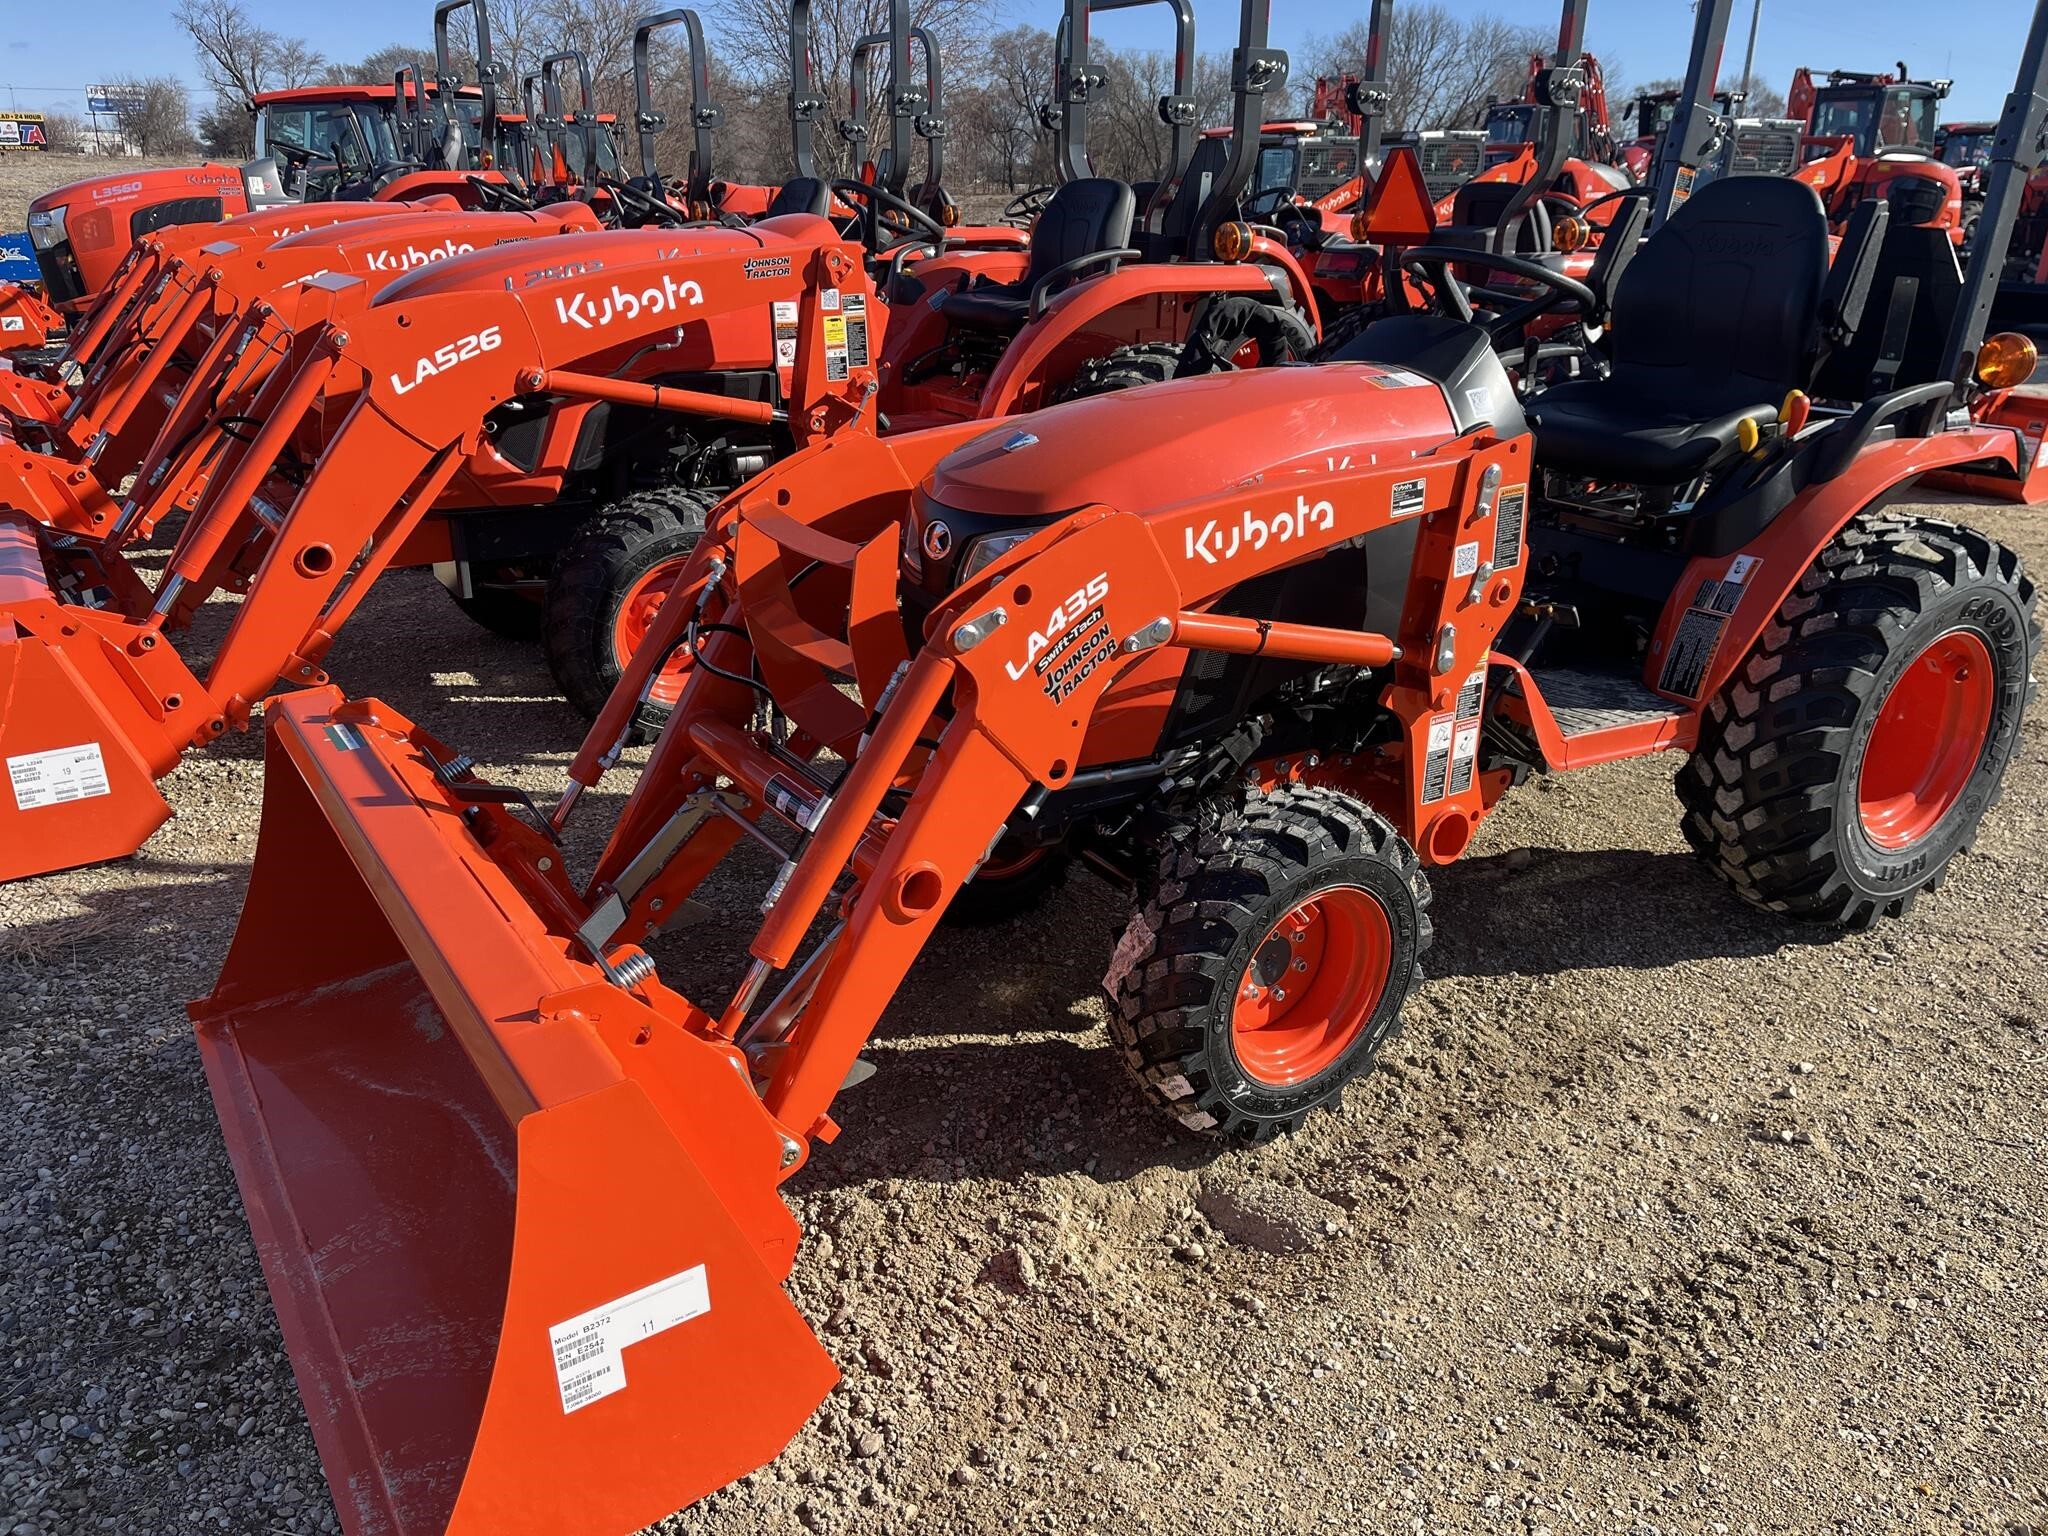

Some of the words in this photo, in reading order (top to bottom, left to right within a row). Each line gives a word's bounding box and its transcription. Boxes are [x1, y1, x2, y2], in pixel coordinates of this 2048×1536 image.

[19, 124, 47, 144] TA
[92, 181, 143, 200] L3560
[185, 174, 238, 185] Kubota
[366, 239, 475, 271] Kubota
[743, 256, 791, 269] JOHNSON
[745, 267, 791, 280] TRACTOR
[555, 275, 704, 329] Kubota
[390, 325, 503, 395] LA526
[1185, 495, 1334, 564] Kubota
[1005, 571, 1109, 681] LA435
[1038, 610, 1102, 673] Swift-Tach
[1043, 623, 1111, 694] JOHNSON
[1049, 638, 1118, 706] TRACTOR
[1958, 596, 2023, 776] GOODYEAR
[62, 767, 72, 775] 19
[1878, 852, 1927, 883] R14T
[554, 1331, 580, 1346] Model
[583, 1316, 612, 1334] B2372
[642, 1319, 655, 1334] 11
[557, 1353, 572, 1363] S/N
[577, 1338, 605, 1355] E2542
